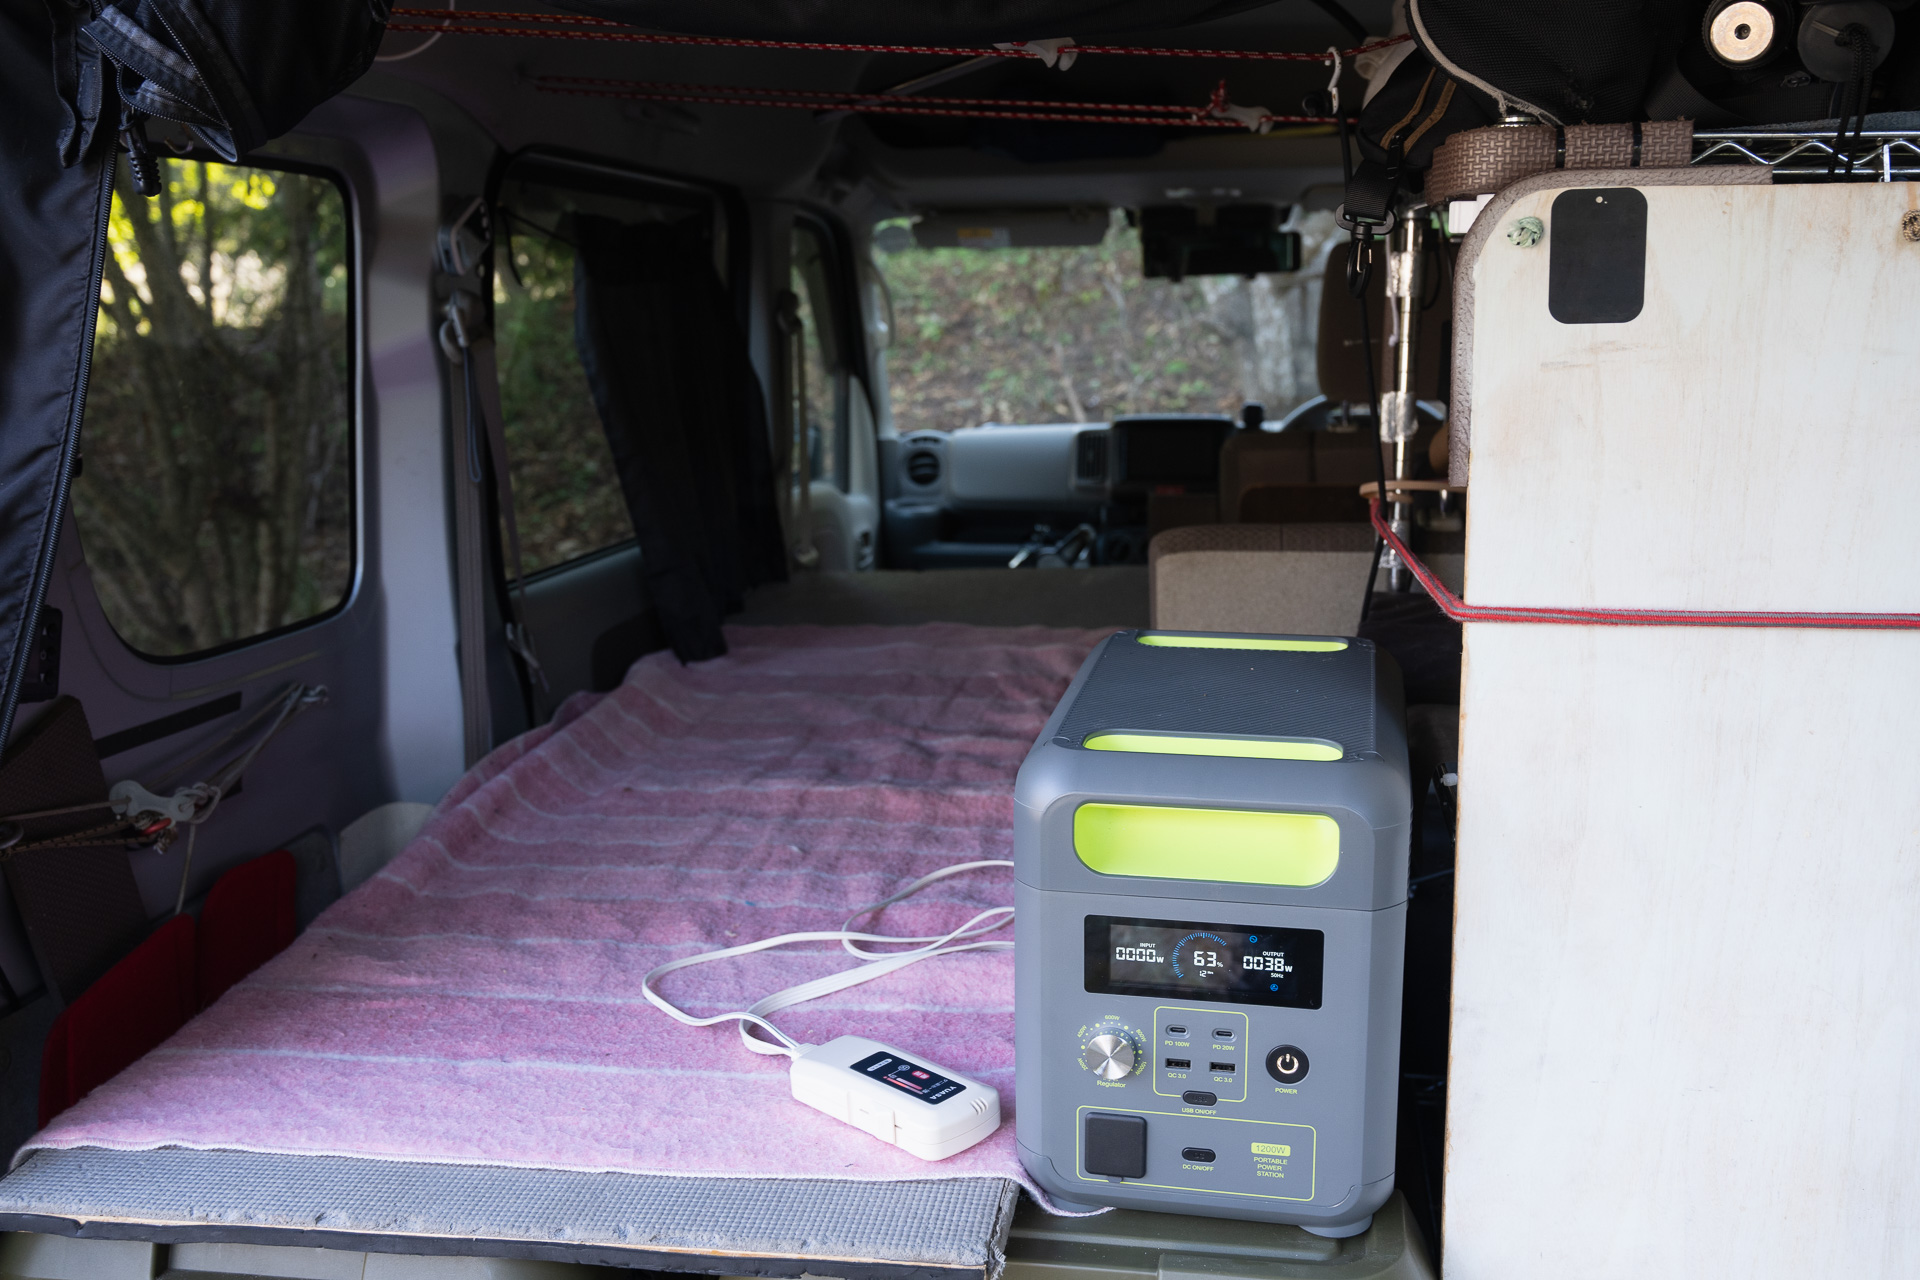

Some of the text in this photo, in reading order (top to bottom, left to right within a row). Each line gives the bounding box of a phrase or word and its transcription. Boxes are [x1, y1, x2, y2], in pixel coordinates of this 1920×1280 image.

[1096, 1080, 1126, 1088] Regulator
[929, 1085, 957, 1100] YUASA
[1274, 1087, 1298, 1095] POWER
[1256, 1144, 1286, 1154] 1200W
[1253, 1156, 1288, 1165] PORTABLE
[1256, 1170, 1285, 1179] STATION
